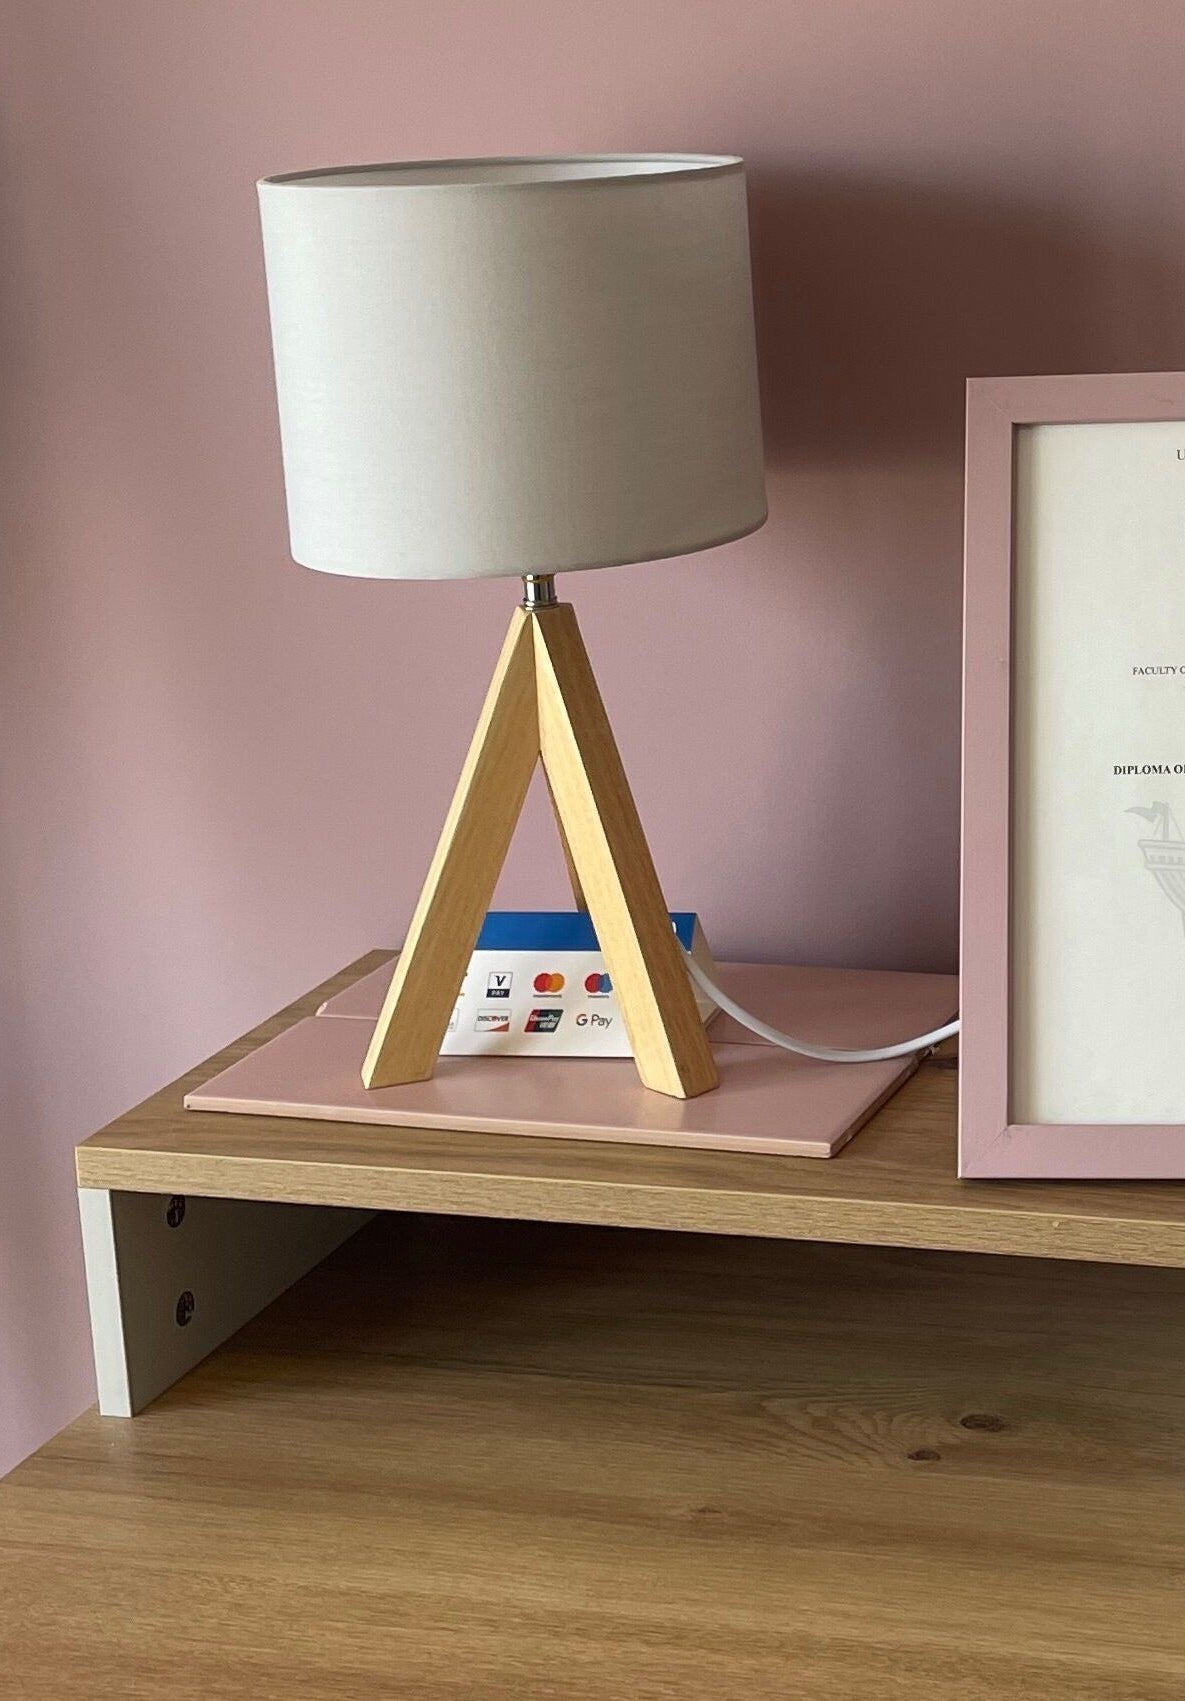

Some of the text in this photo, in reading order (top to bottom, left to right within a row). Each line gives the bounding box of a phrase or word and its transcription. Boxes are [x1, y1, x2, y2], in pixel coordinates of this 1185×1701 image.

[1132, 666, 1176, 676] FACULTY
[1113, 764, 1171, 775] DIPLOMA
[576, 1013, 588, 1027] G
[590, 1013, 613, 1028] Pay
